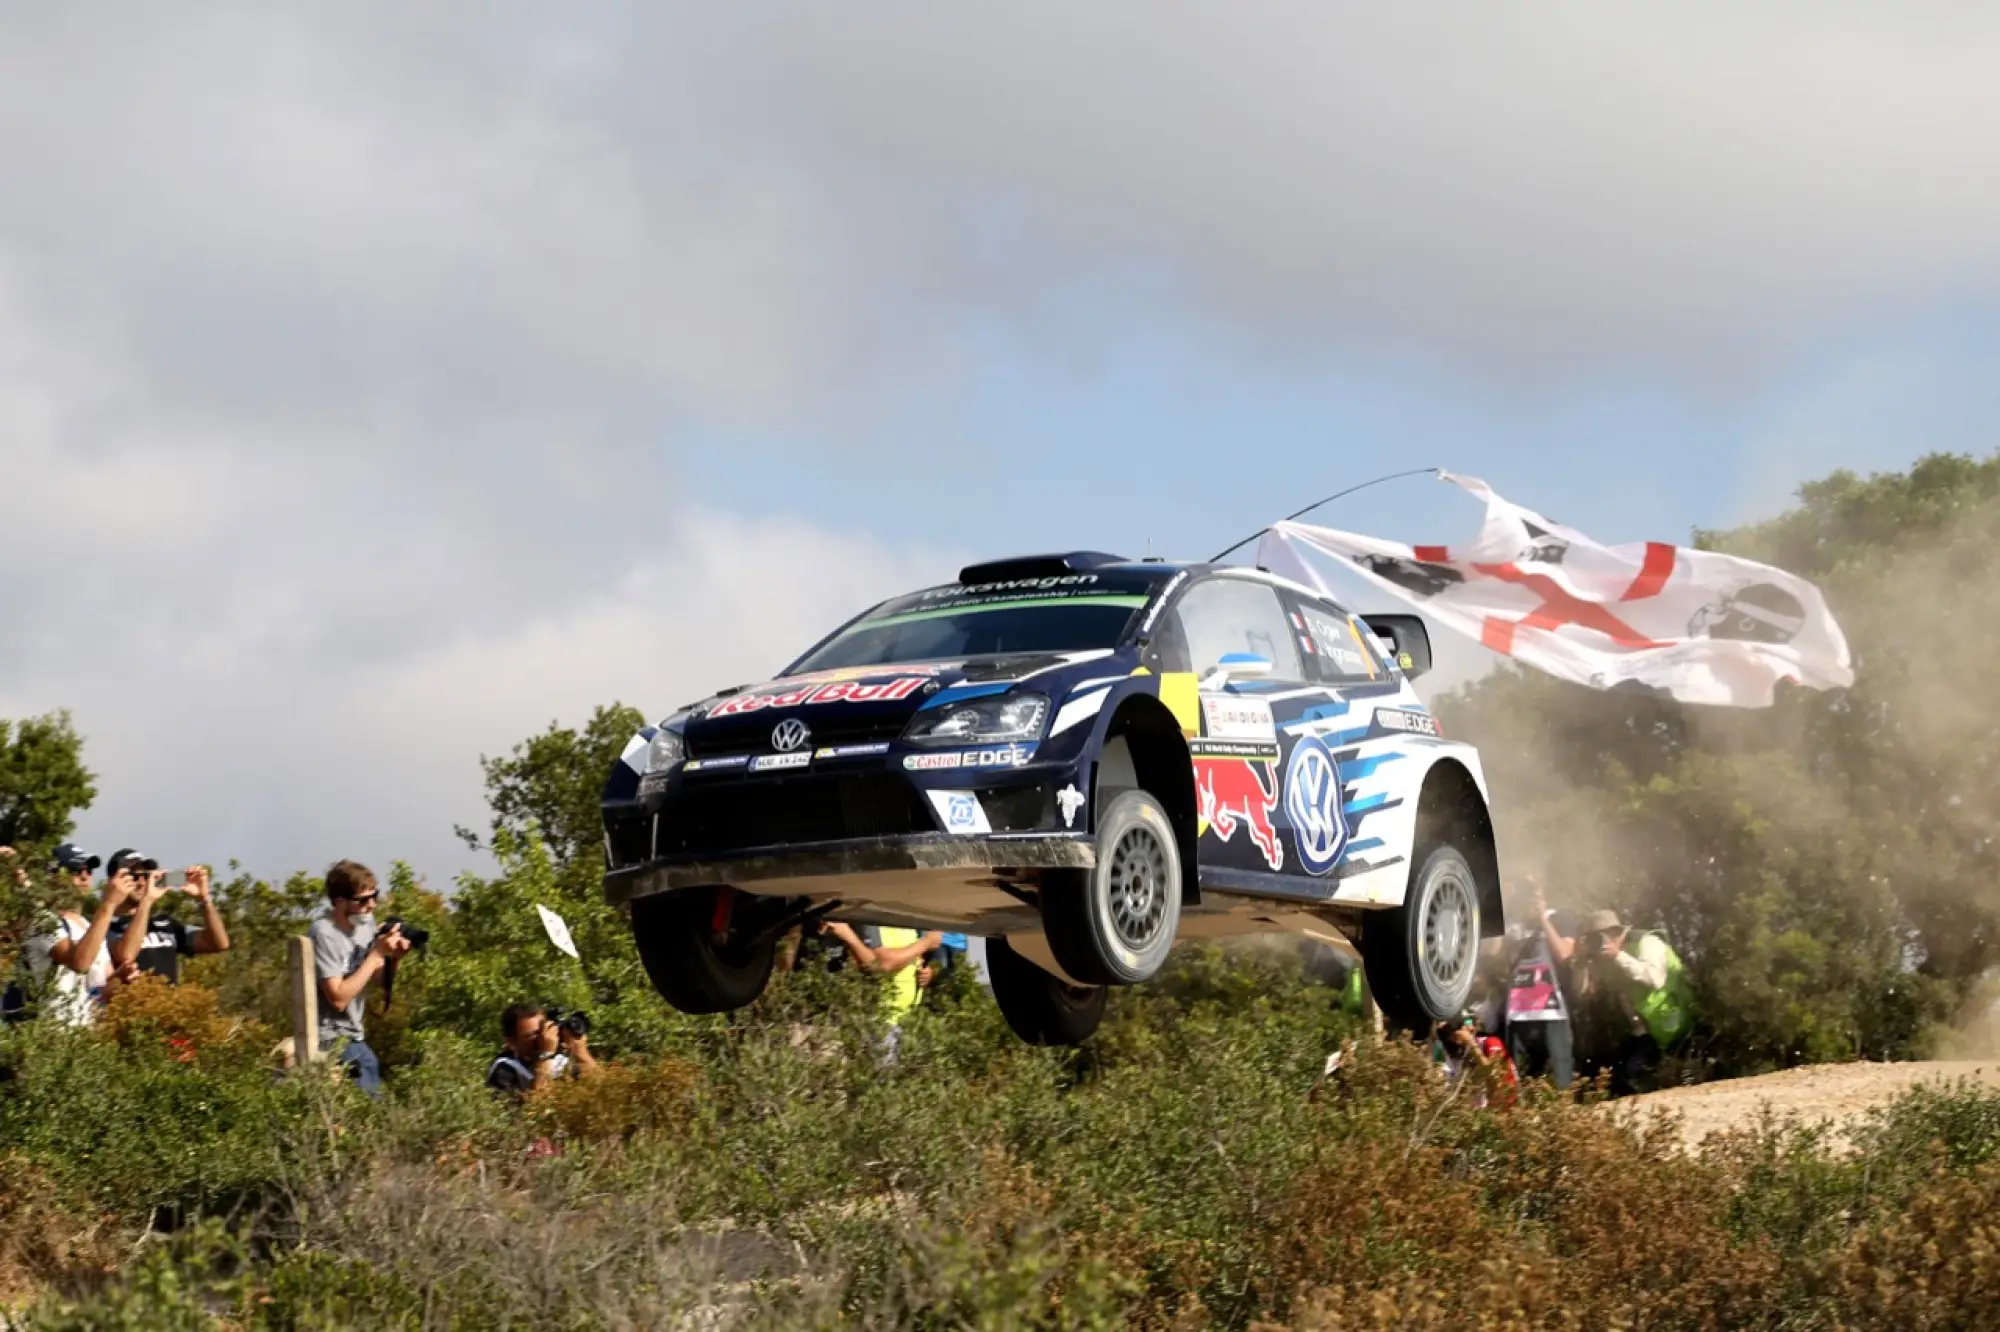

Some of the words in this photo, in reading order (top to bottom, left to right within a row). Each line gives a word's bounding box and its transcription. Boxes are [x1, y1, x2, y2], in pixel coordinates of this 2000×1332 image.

[706, 684, 818, 719] Red
[805, 678, 930, 704] Bull
[916, 754, 959, 769] Castrol
[962, 749, 1029, 767] EDGE
